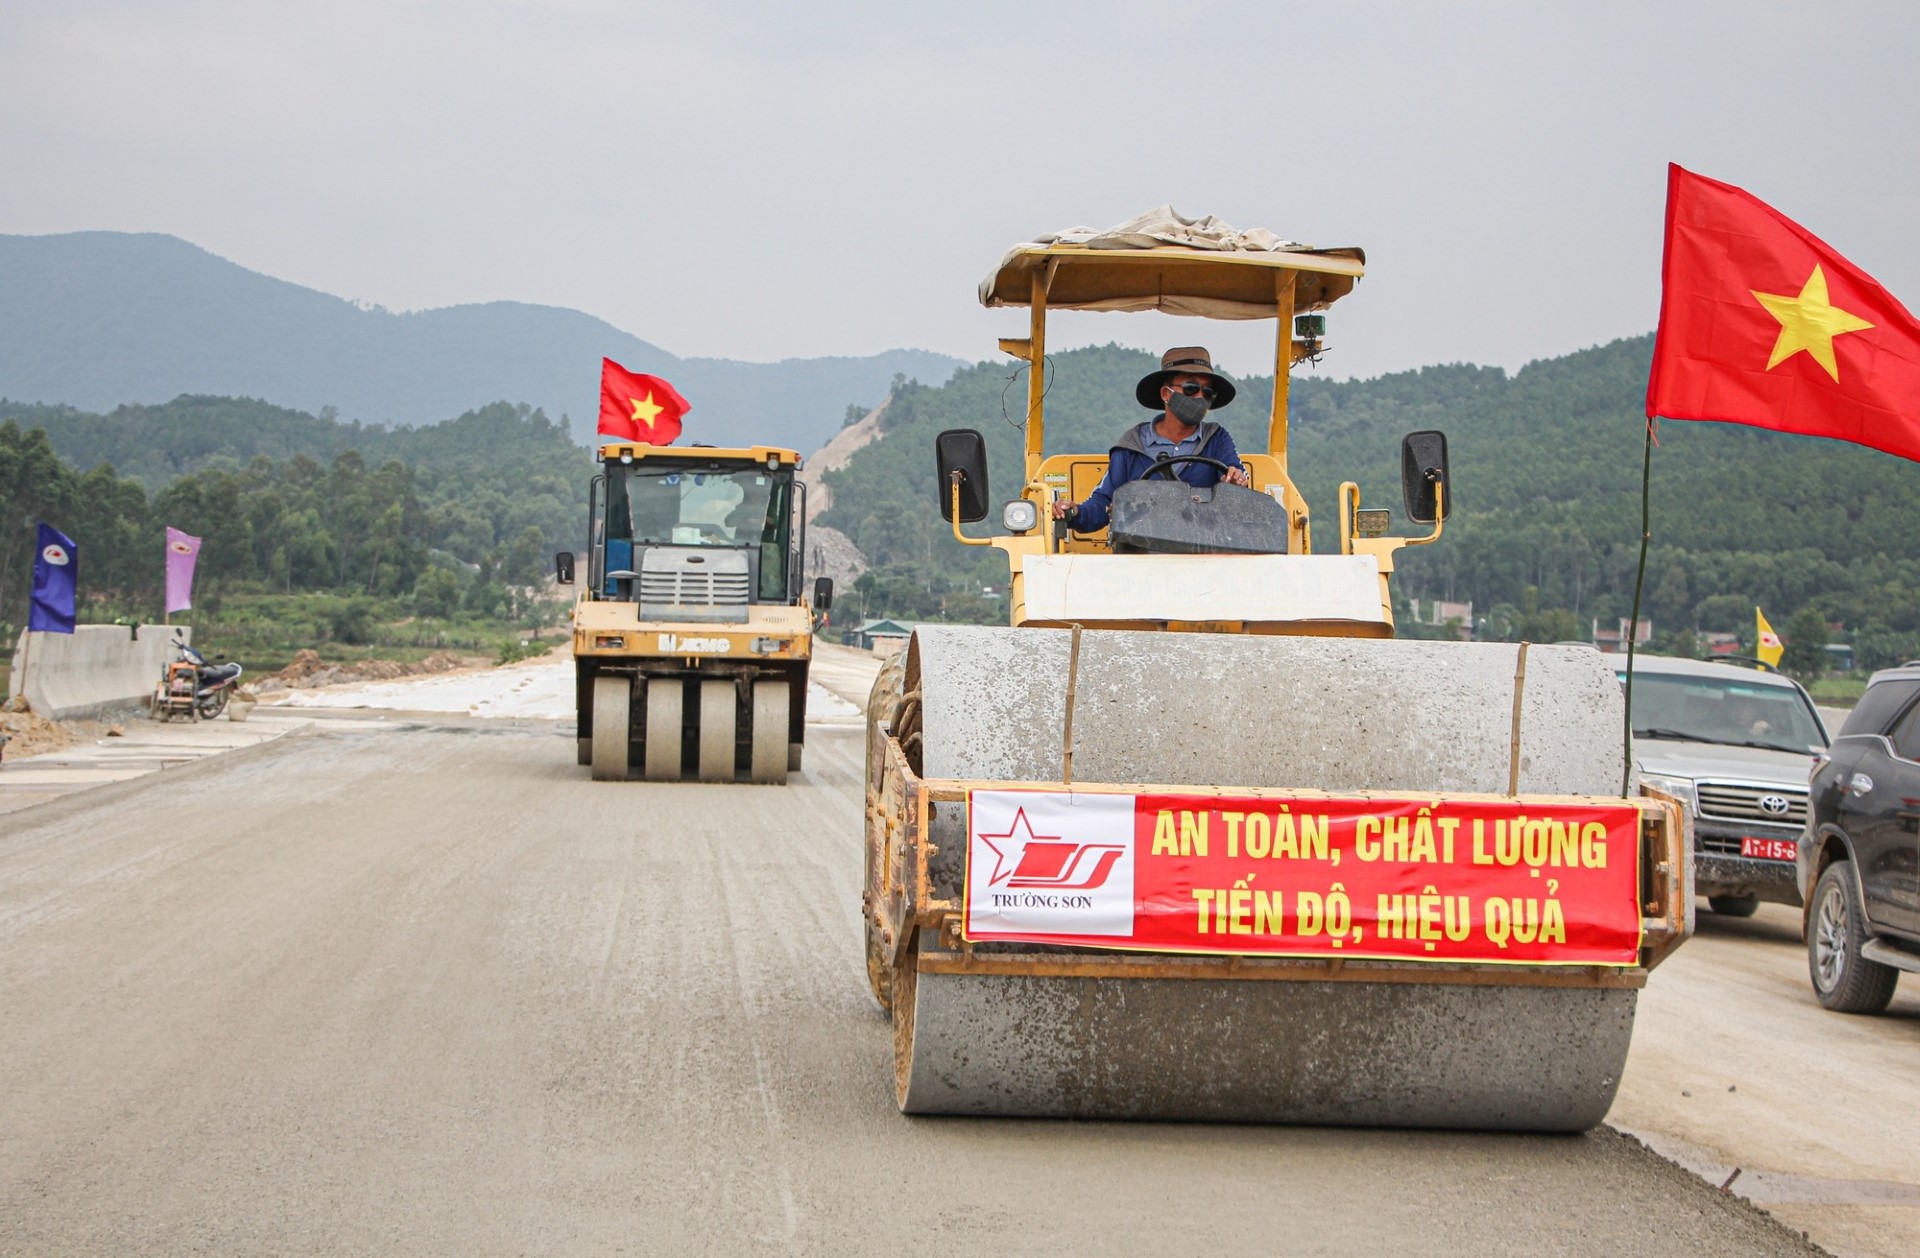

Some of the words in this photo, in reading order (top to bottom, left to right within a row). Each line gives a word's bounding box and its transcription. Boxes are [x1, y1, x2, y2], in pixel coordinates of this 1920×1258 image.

[1151, 809, 1208, 857] AN
[1221, 803, 1341, 867] TOÀN,
[1355, 801, 1460, 863] CHẤT
[1472, 815, 1607, 878] LƯỢNG
[992, 892, 1058, 909] TRƯỜNG
[1061, 894, 1093, 909] SƠN
[1191, 872, 1283, 935] TIẾN
[1296, 882, 1363, 948] ĐỘ,
[1377, 884, 1471, 951] HIỆU
[1484, 878, 1567, 948] QUẢ
